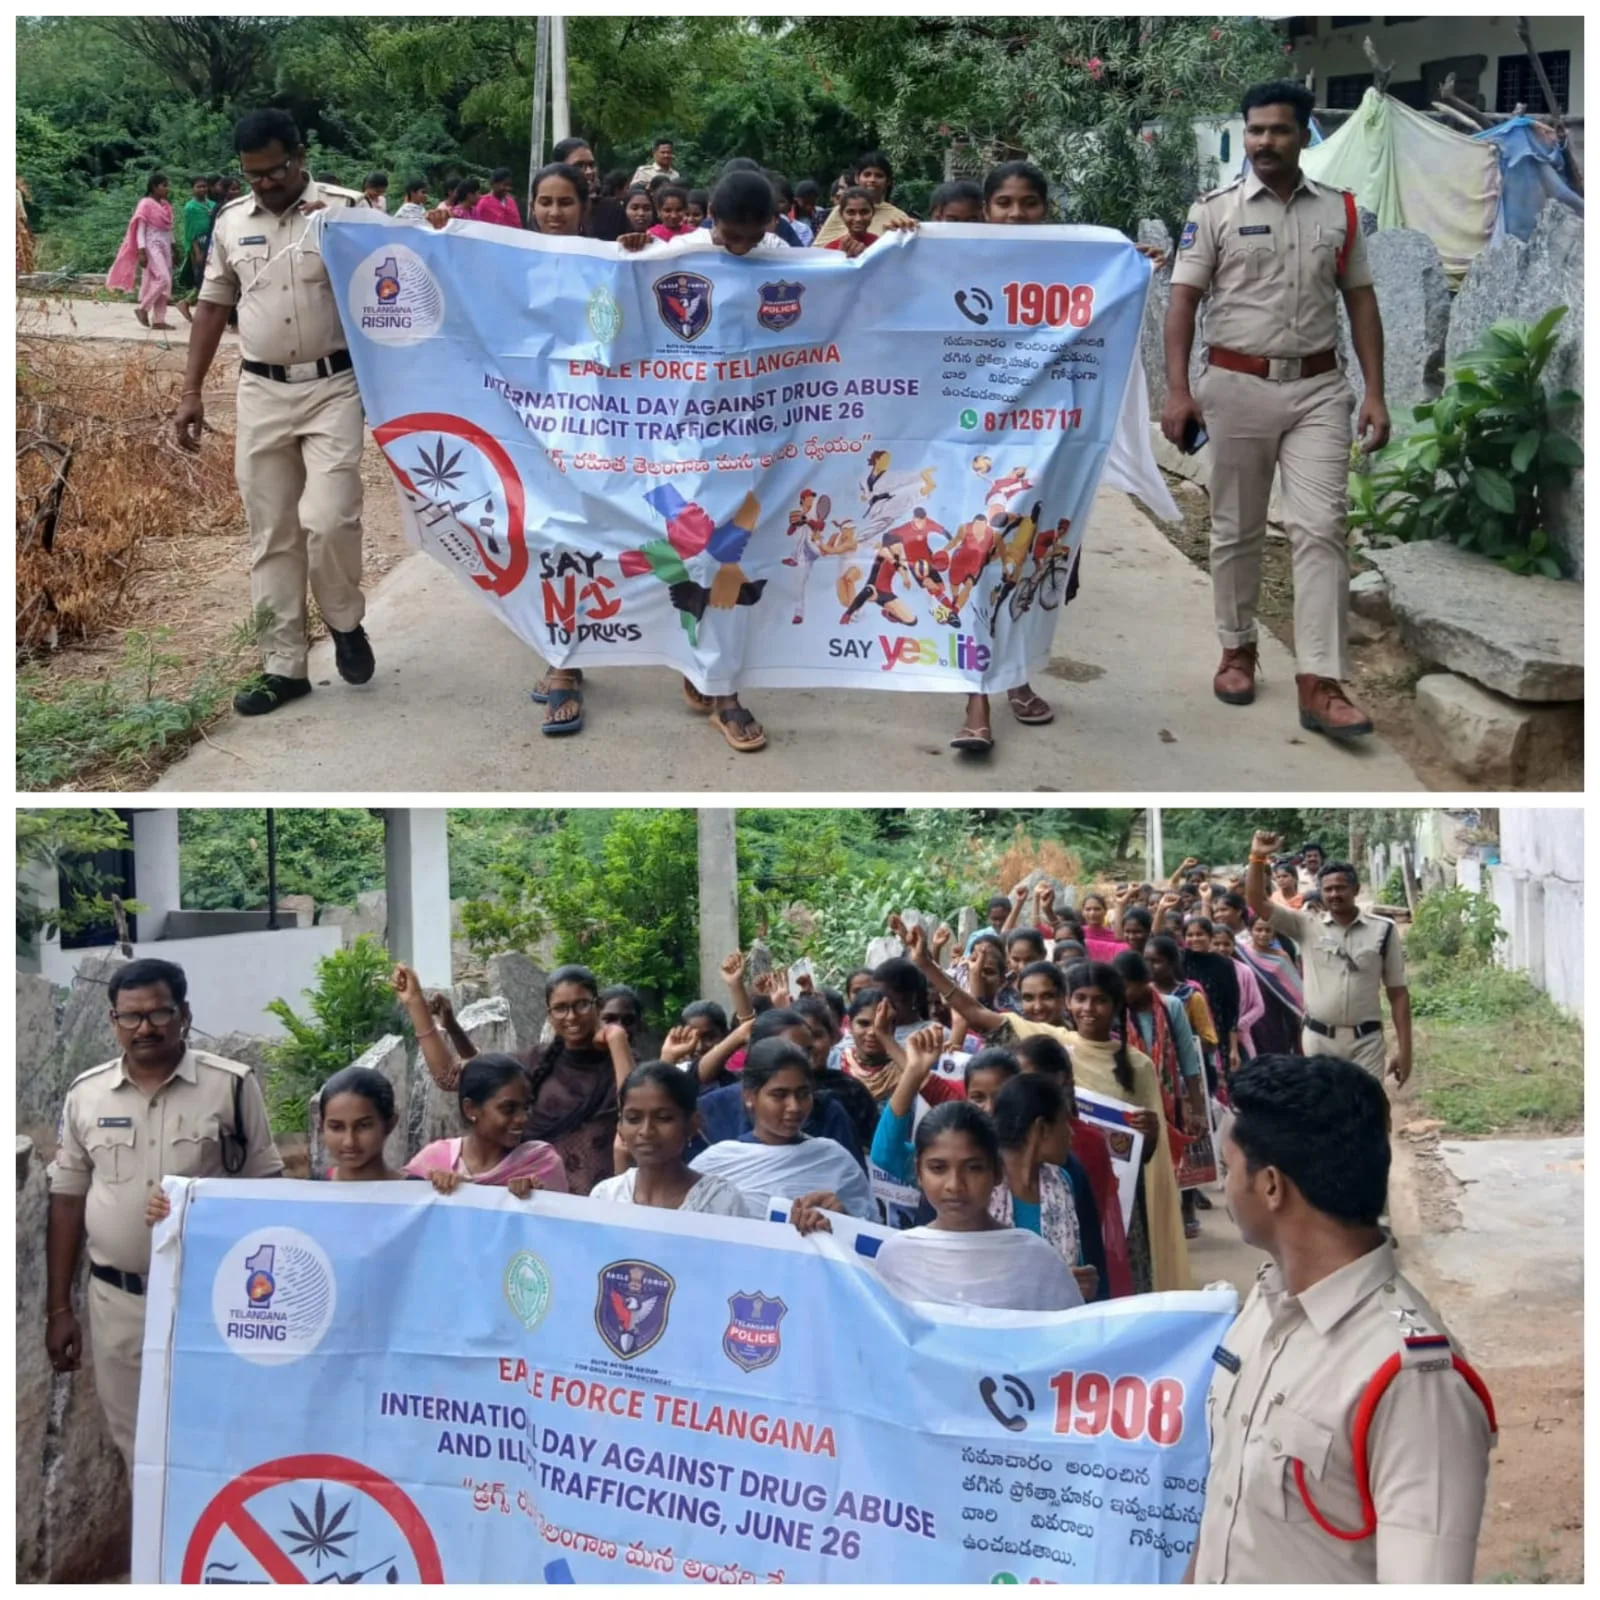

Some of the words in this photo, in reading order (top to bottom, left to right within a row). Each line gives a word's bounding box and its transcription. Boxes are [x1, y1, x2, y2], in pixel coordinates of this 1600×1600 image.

[362, 316, 412, 328] RISING
[761, 304, 799, 315] POLICE
[1002, 282, 1095, 328] 1908
[639, 359, 708, 381] FORCE
[714, 343, 841, 381] TELANGANA
[637, 397, 680, 416] DAY
[684, 389, 777, 416] AGAINST
[782, 380, 839, 404] DRUG
[843, 378, 919, 397] ABUSE
[517, 411, 557, 433] ND
[561, 415, 629, 438] ILLICIT
[635, 415, 778, 441] TRAFFICKING,
[782, 404, 833, 428] JUNE
[838, 401, 865, 419] 26
[539, 551, 603, 580] SAY
[545, 623, 572, 646] TO
[578, 623, 642, 644] DRUGS
[828, 638, 873, 659] SAY
[878, 635, 939, 671] yes
[948, 633, 991, 672] life
[227, 1322, 288, 1342] RISING
[228, 1308, 288, 1322] TELANGANA
[730, 1325, 777, 1344] POLICE
[498, 1357, 545, 1398] EAE
[551, 1375, 646, 1419] FORCE
[653, 1394, 837, 1457] TELANGANA
[1050, 1371, 1184, 1446] 1908
[381, 1392, 538, 1448] INTERNATIOL
[541, 1428, 598, 1463] DAY
[601, 1442, 735, 1493] AGAINST
[739, 1469, 827, 1513] DRUG
[833, 1492, 938, 1540] ABUSE
[437, 1431, 492, 1459] AND
[539, 1462, 727, 1536] TRAFFICKING,
[735, 1511, 812, 1551] JUNE
[820, 1526, 861, 1560] 26
